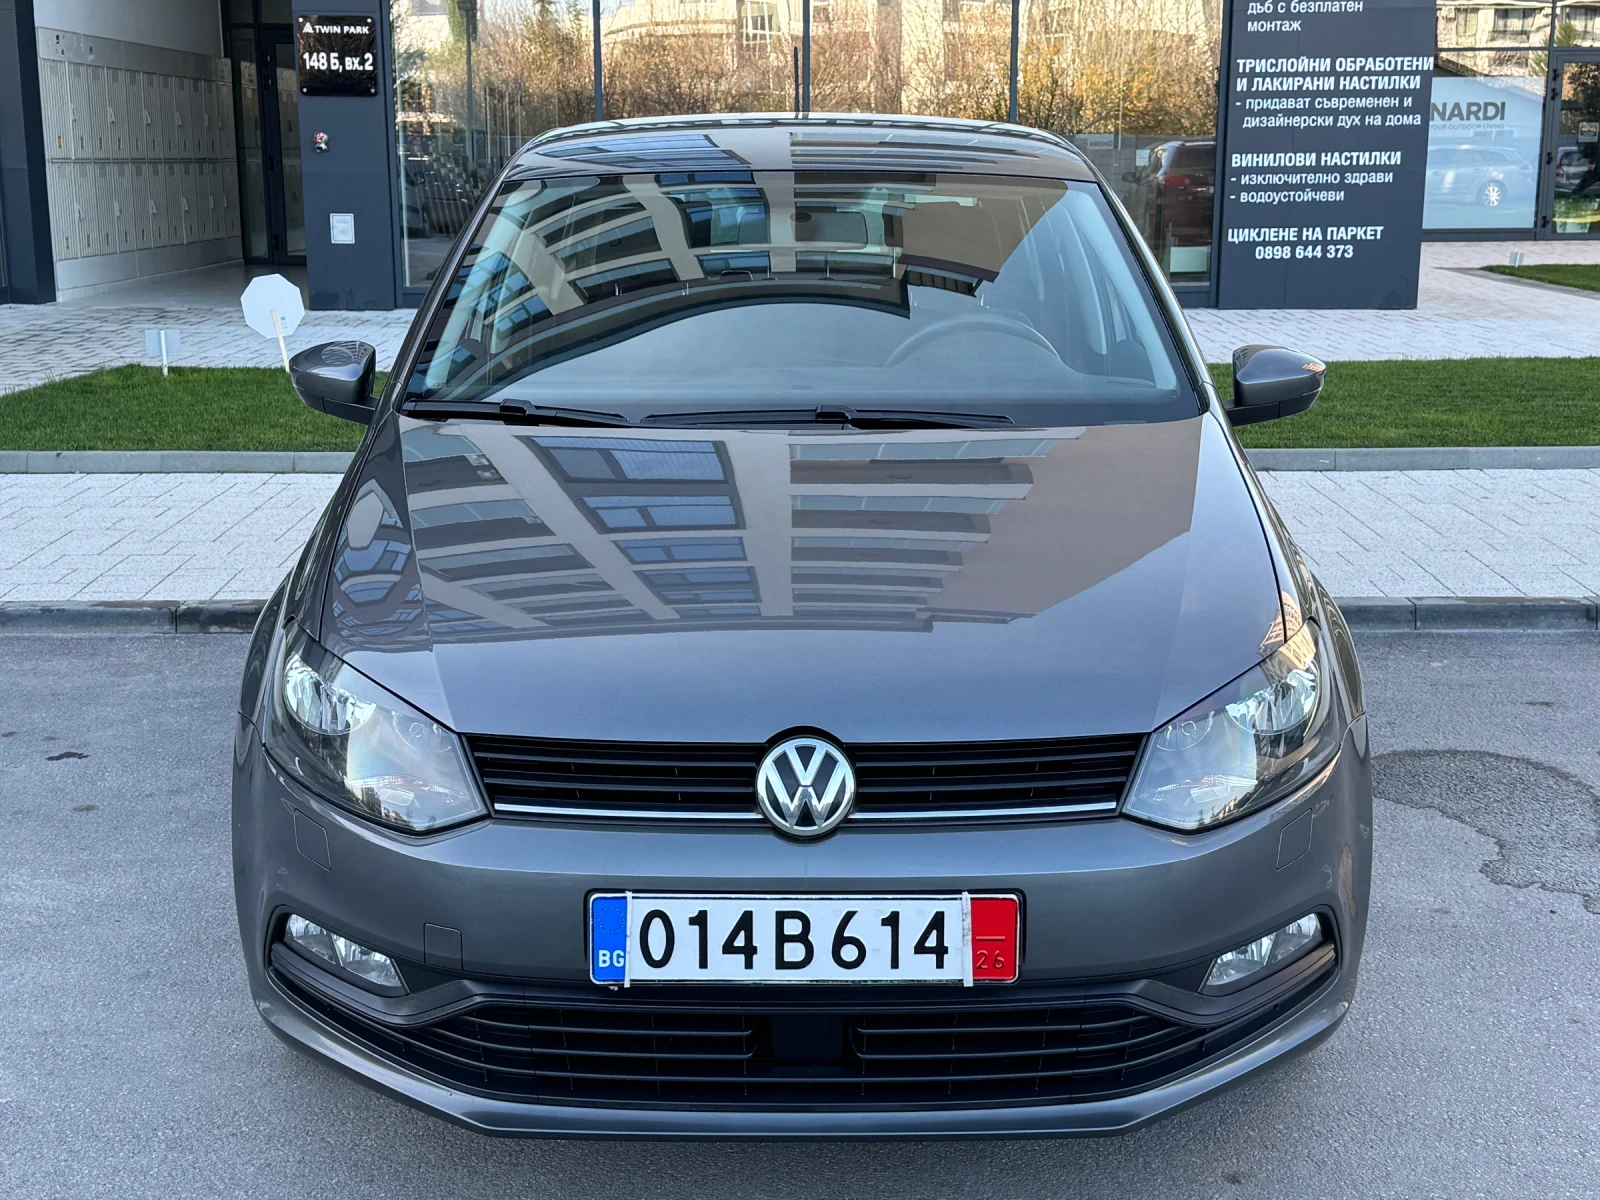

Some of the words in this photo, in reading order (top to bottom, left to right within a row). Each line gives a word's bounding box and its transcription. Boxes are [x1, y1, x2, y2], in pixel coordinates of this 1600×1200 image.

[1277, 2, 1286, 13] с
[1290, 0, 1363, 14] безплатен
[314, 25, 341, 34] TWIN
[343, 25, 369, 34] PARK
[1247, 20, 1302, 32] монтаж
[303, 51, 328, 70] 148
[1236, 56, 1331, 73] ТРИСЛОЙНИ
[1335, 56, 1434, 72] ОБРАБОТЕНИ
[1236, 77, 1247, 92] И
[1251, 76, 1335, 92] ЛАКИРАНИ
[1339, 75, 1421, 91] НАСТИЛКИ
[1245, 97, 1310, 112] придават
[1314, 96, 1400, 111] съвременен
[1403, 96, 1413, 108] и
[1430, 101, 1506, 121] NARDI
[1242, 113, 1334, 129] дизайнерски
[1336, 114, 1361, 129] дух
[1365, 114, 1382, 126] на
[1385, 113, 1421, 127] дома
[1231, 152, 1317, 168] ВИНИЛОВИ
[1320, 151, 1402, 166] НАСТИЛКИ
[1241, 172, 1341, 186] изключително
[1344, 171, 1394, 186] здрави
[1240, 188, 1345, 205] водоустойчеви
[1227, 227, 1299, 244] ЦИКЛЕНЕ
[1302, 227, 1323, 241] НА
[1326, 226, 1384, 241] ПАРКЕТ
[1255, 246, 1291, 260] 0898
[1295, 245, 1322, 259] 644
[1326, 244, 1354, 259] 373
[639, 908, 949, 970] 014B614
[598, 950, 625, 968] BG
[976, 949, 1005, 970] 26
